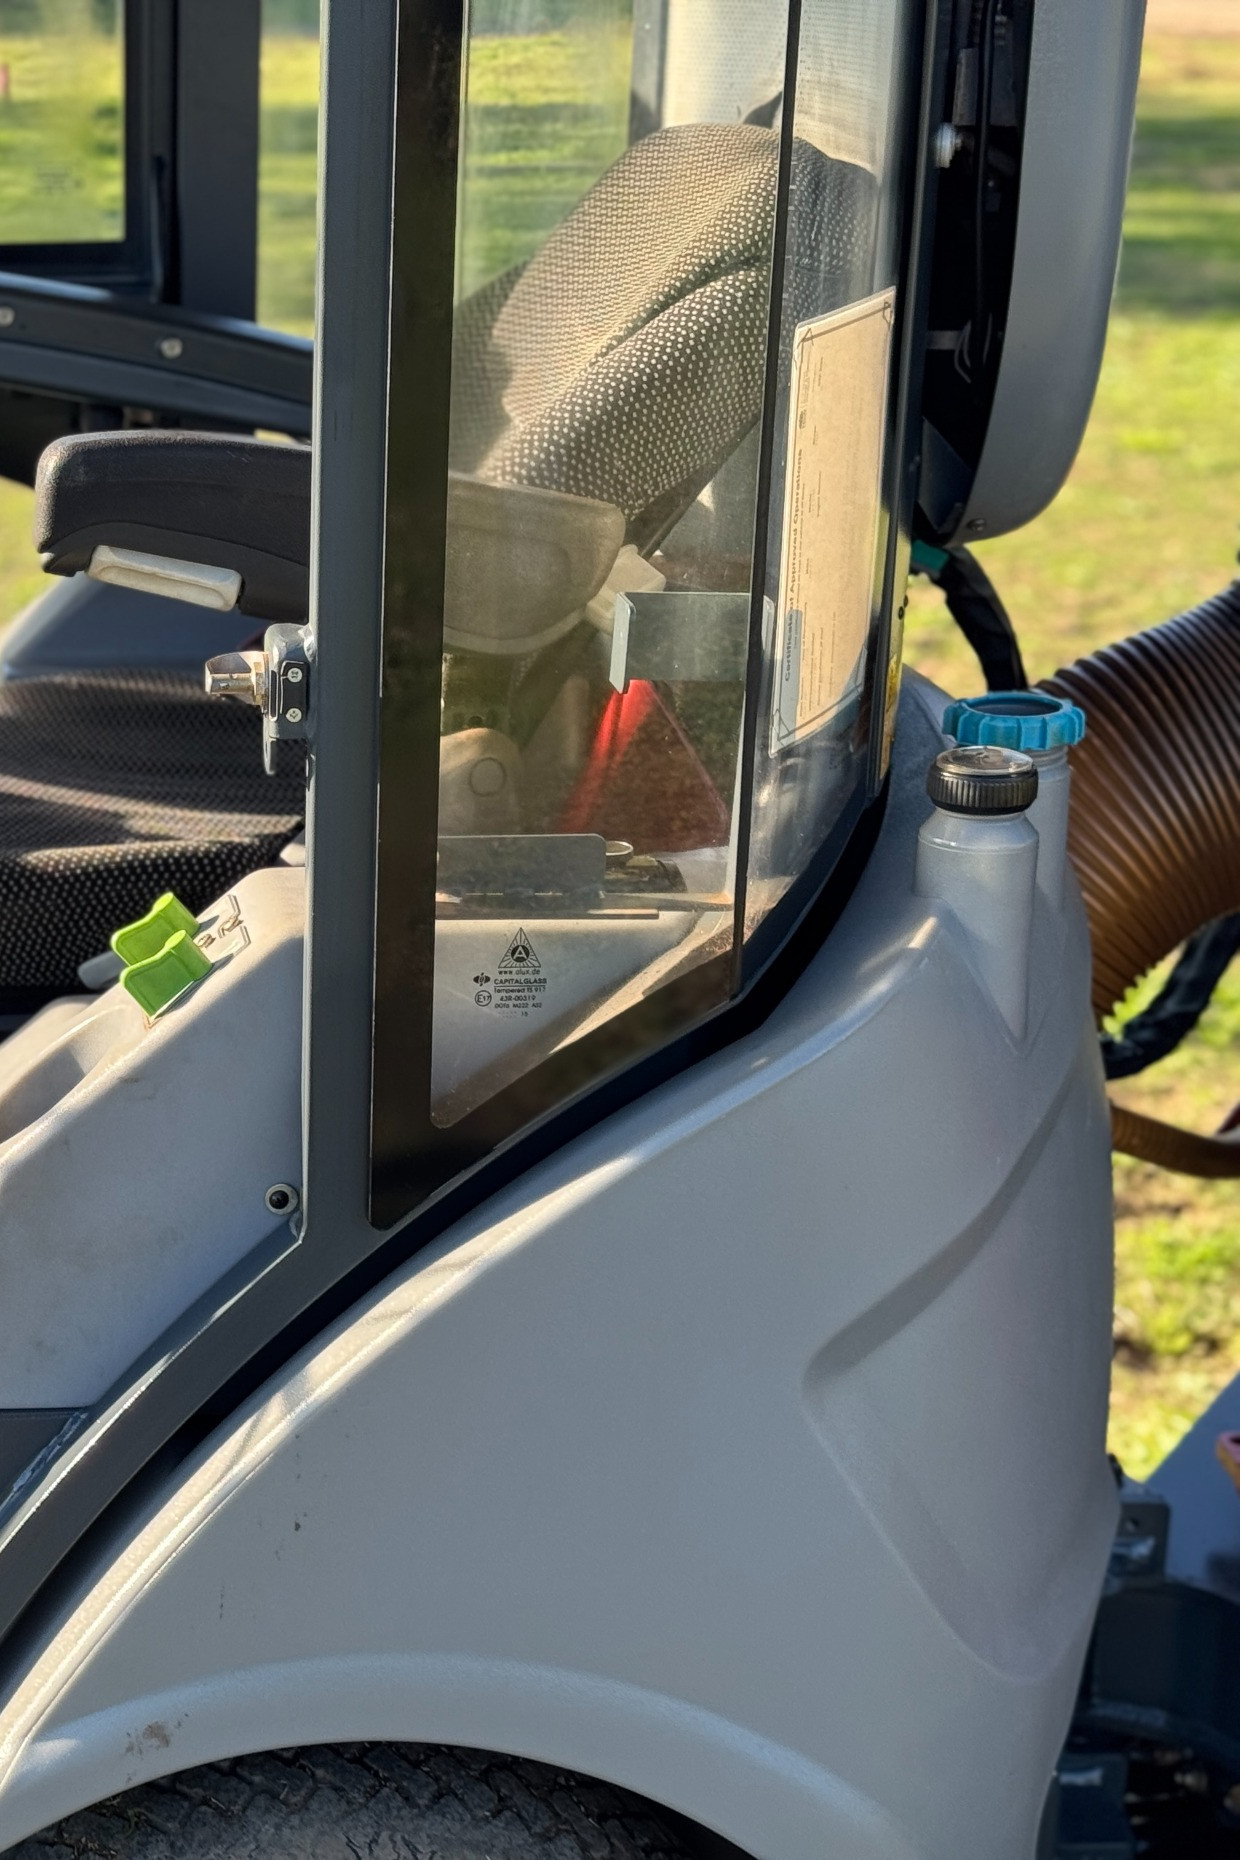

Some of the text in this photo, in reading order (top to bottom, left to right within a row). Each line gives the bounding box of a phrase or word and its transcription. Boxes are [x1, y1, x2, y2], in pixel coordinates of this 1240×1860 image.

[793, 448, 802, 524] Operations
[790, 528, 798, 593] Approved
[785, 613, 793, 681] Certificate
